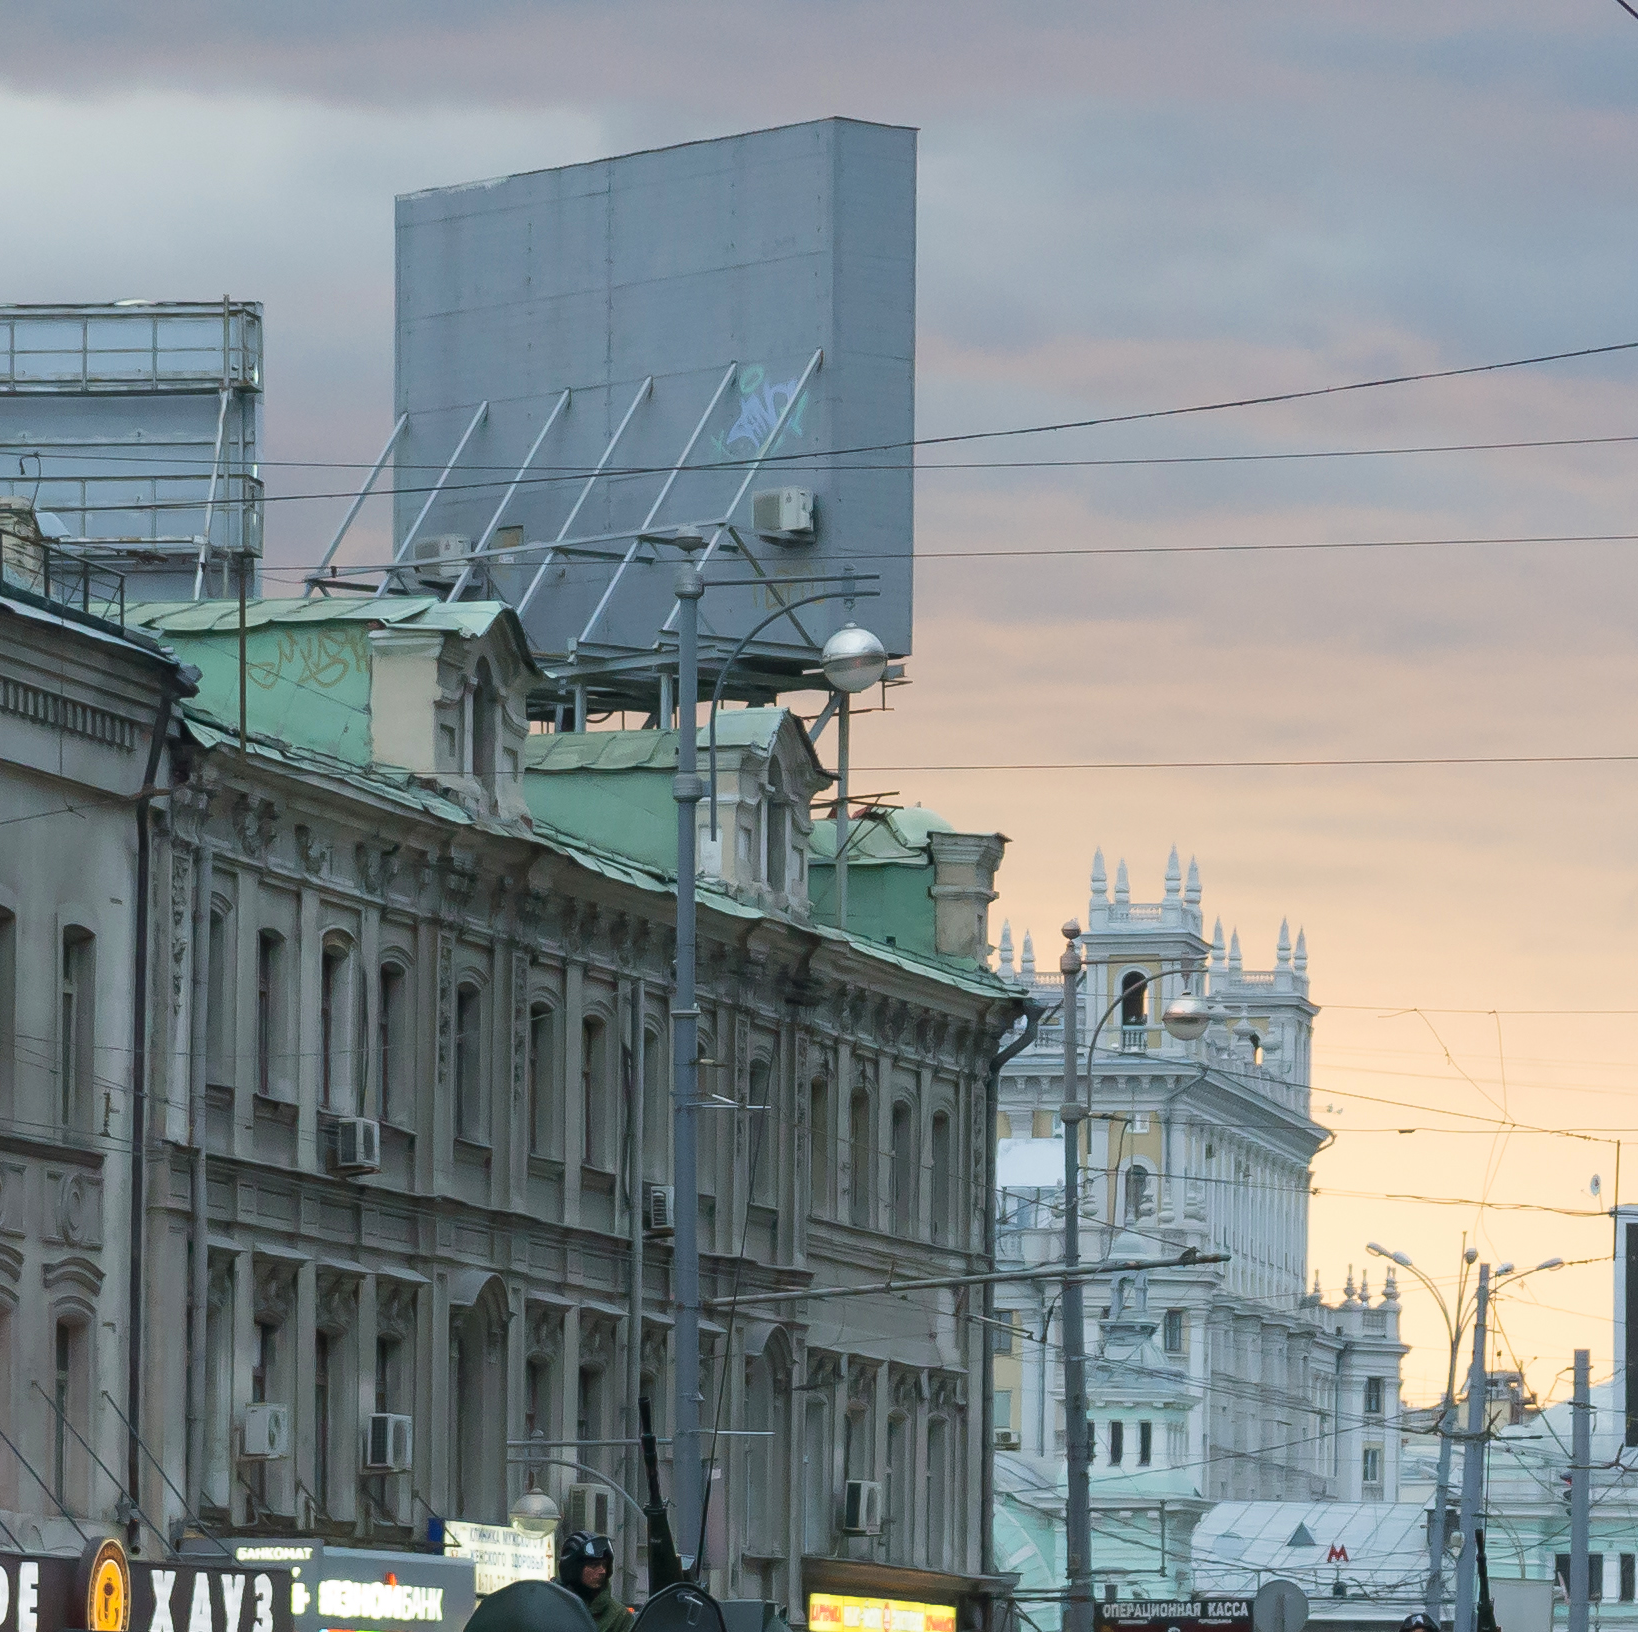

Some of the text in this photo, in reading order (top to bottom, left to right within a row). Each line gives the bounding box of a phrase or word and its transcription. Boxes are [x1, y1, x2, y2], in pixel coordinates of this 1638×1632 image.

[235, 1546, 314, 1561] БАНКОМАТ
[1102, 1601, 1249, 1619] ОПЕРАЦИОННАЯ КАССА
